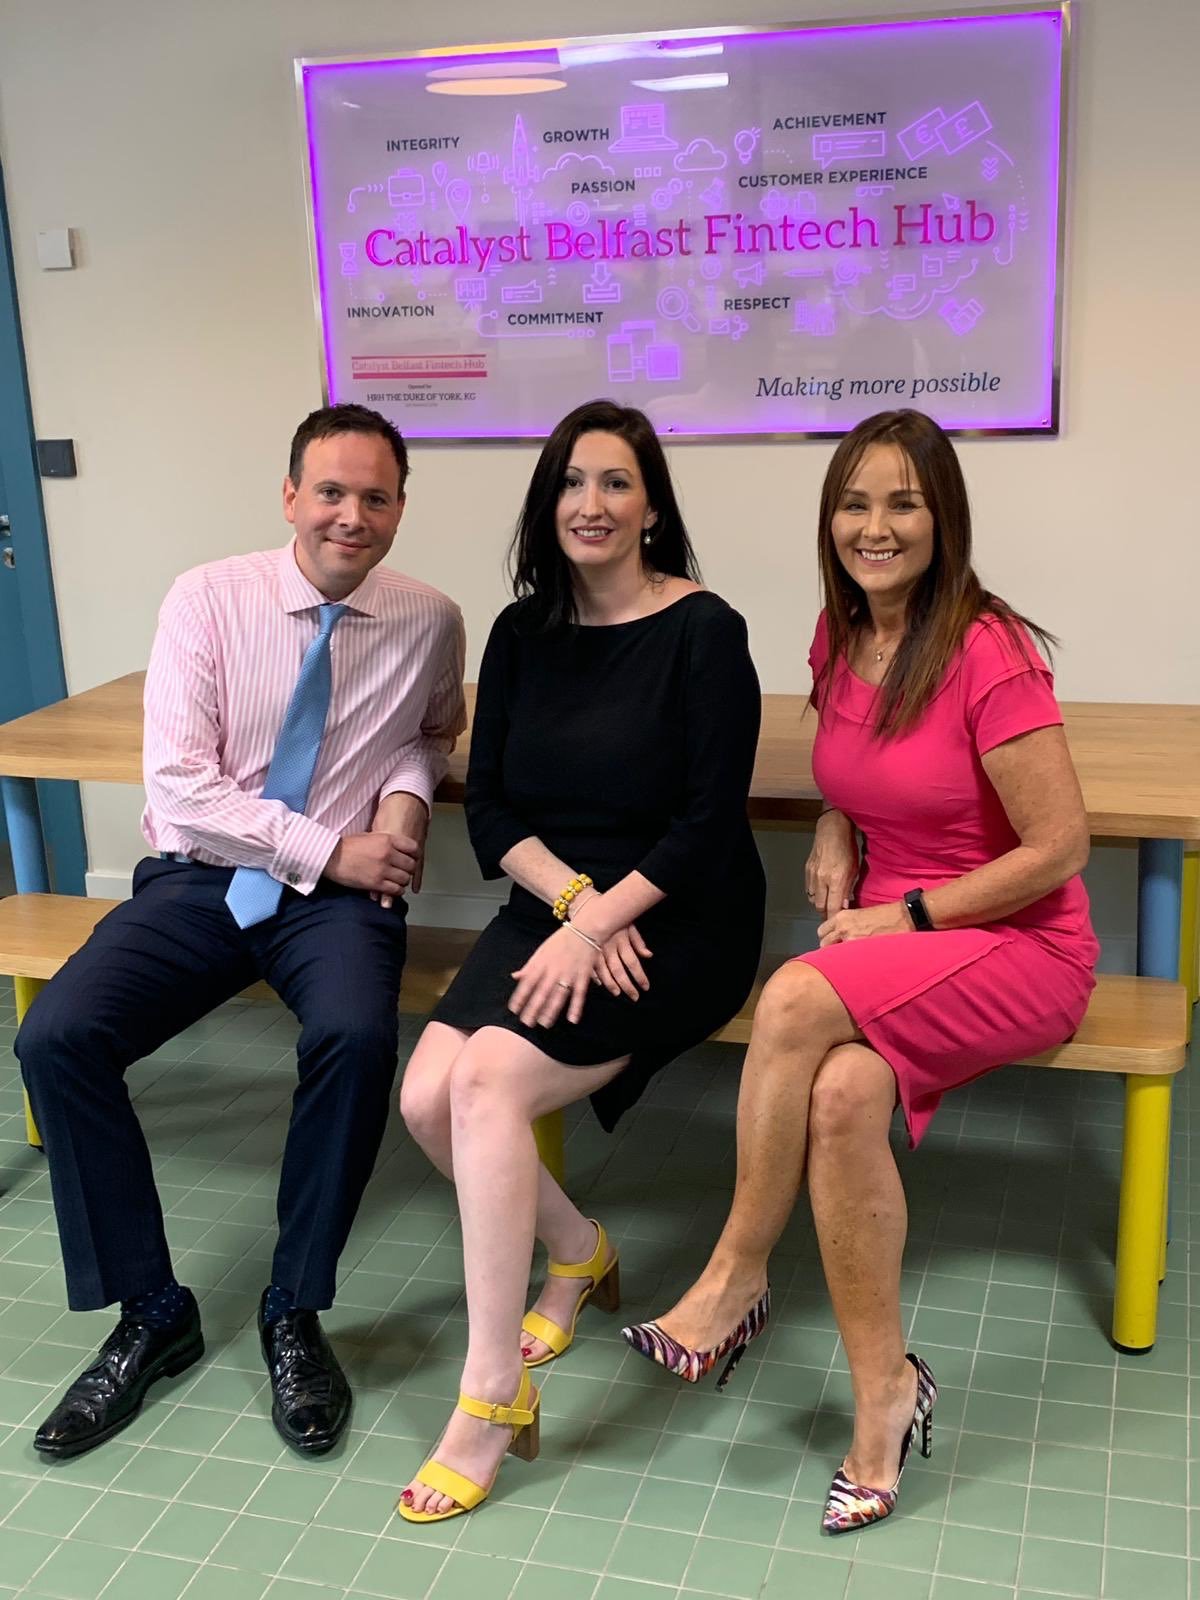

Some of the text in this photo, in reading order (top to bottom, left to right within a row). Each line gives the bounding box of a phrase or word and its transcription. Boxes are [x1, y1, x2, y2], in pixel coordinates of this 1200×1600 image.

[773, 112, 887, 130] ACHIEVEMENT
[543, 128, 609, 143] GROWTH
[386, 137, 460, 152] INTEGRITY
[738, 167, 928, 188] CUSTOMER EXPERIENCE
[571, 180, 635, 194] PASSION
[365, 200, 995, 272] Catalyst Belfast Fintech Hub
[724, 297, 791, 311] RESPECT
[347, 305, 435, 318] INNOVATION
[507, 311, 604, 325] COMMITMENT
[351, 360, 389, 372] Catalyst
[425, 360, 462, 369] Fintech
[464, 359, 485, 369] Hub
[756, 371, 1001, 400] Making more possible
[367, 393, 385, 401] HRH
[386, 393, 401, 401] THE
[403, 393, 425, 401] DUKE
[464, 392, 476, 400] KG
